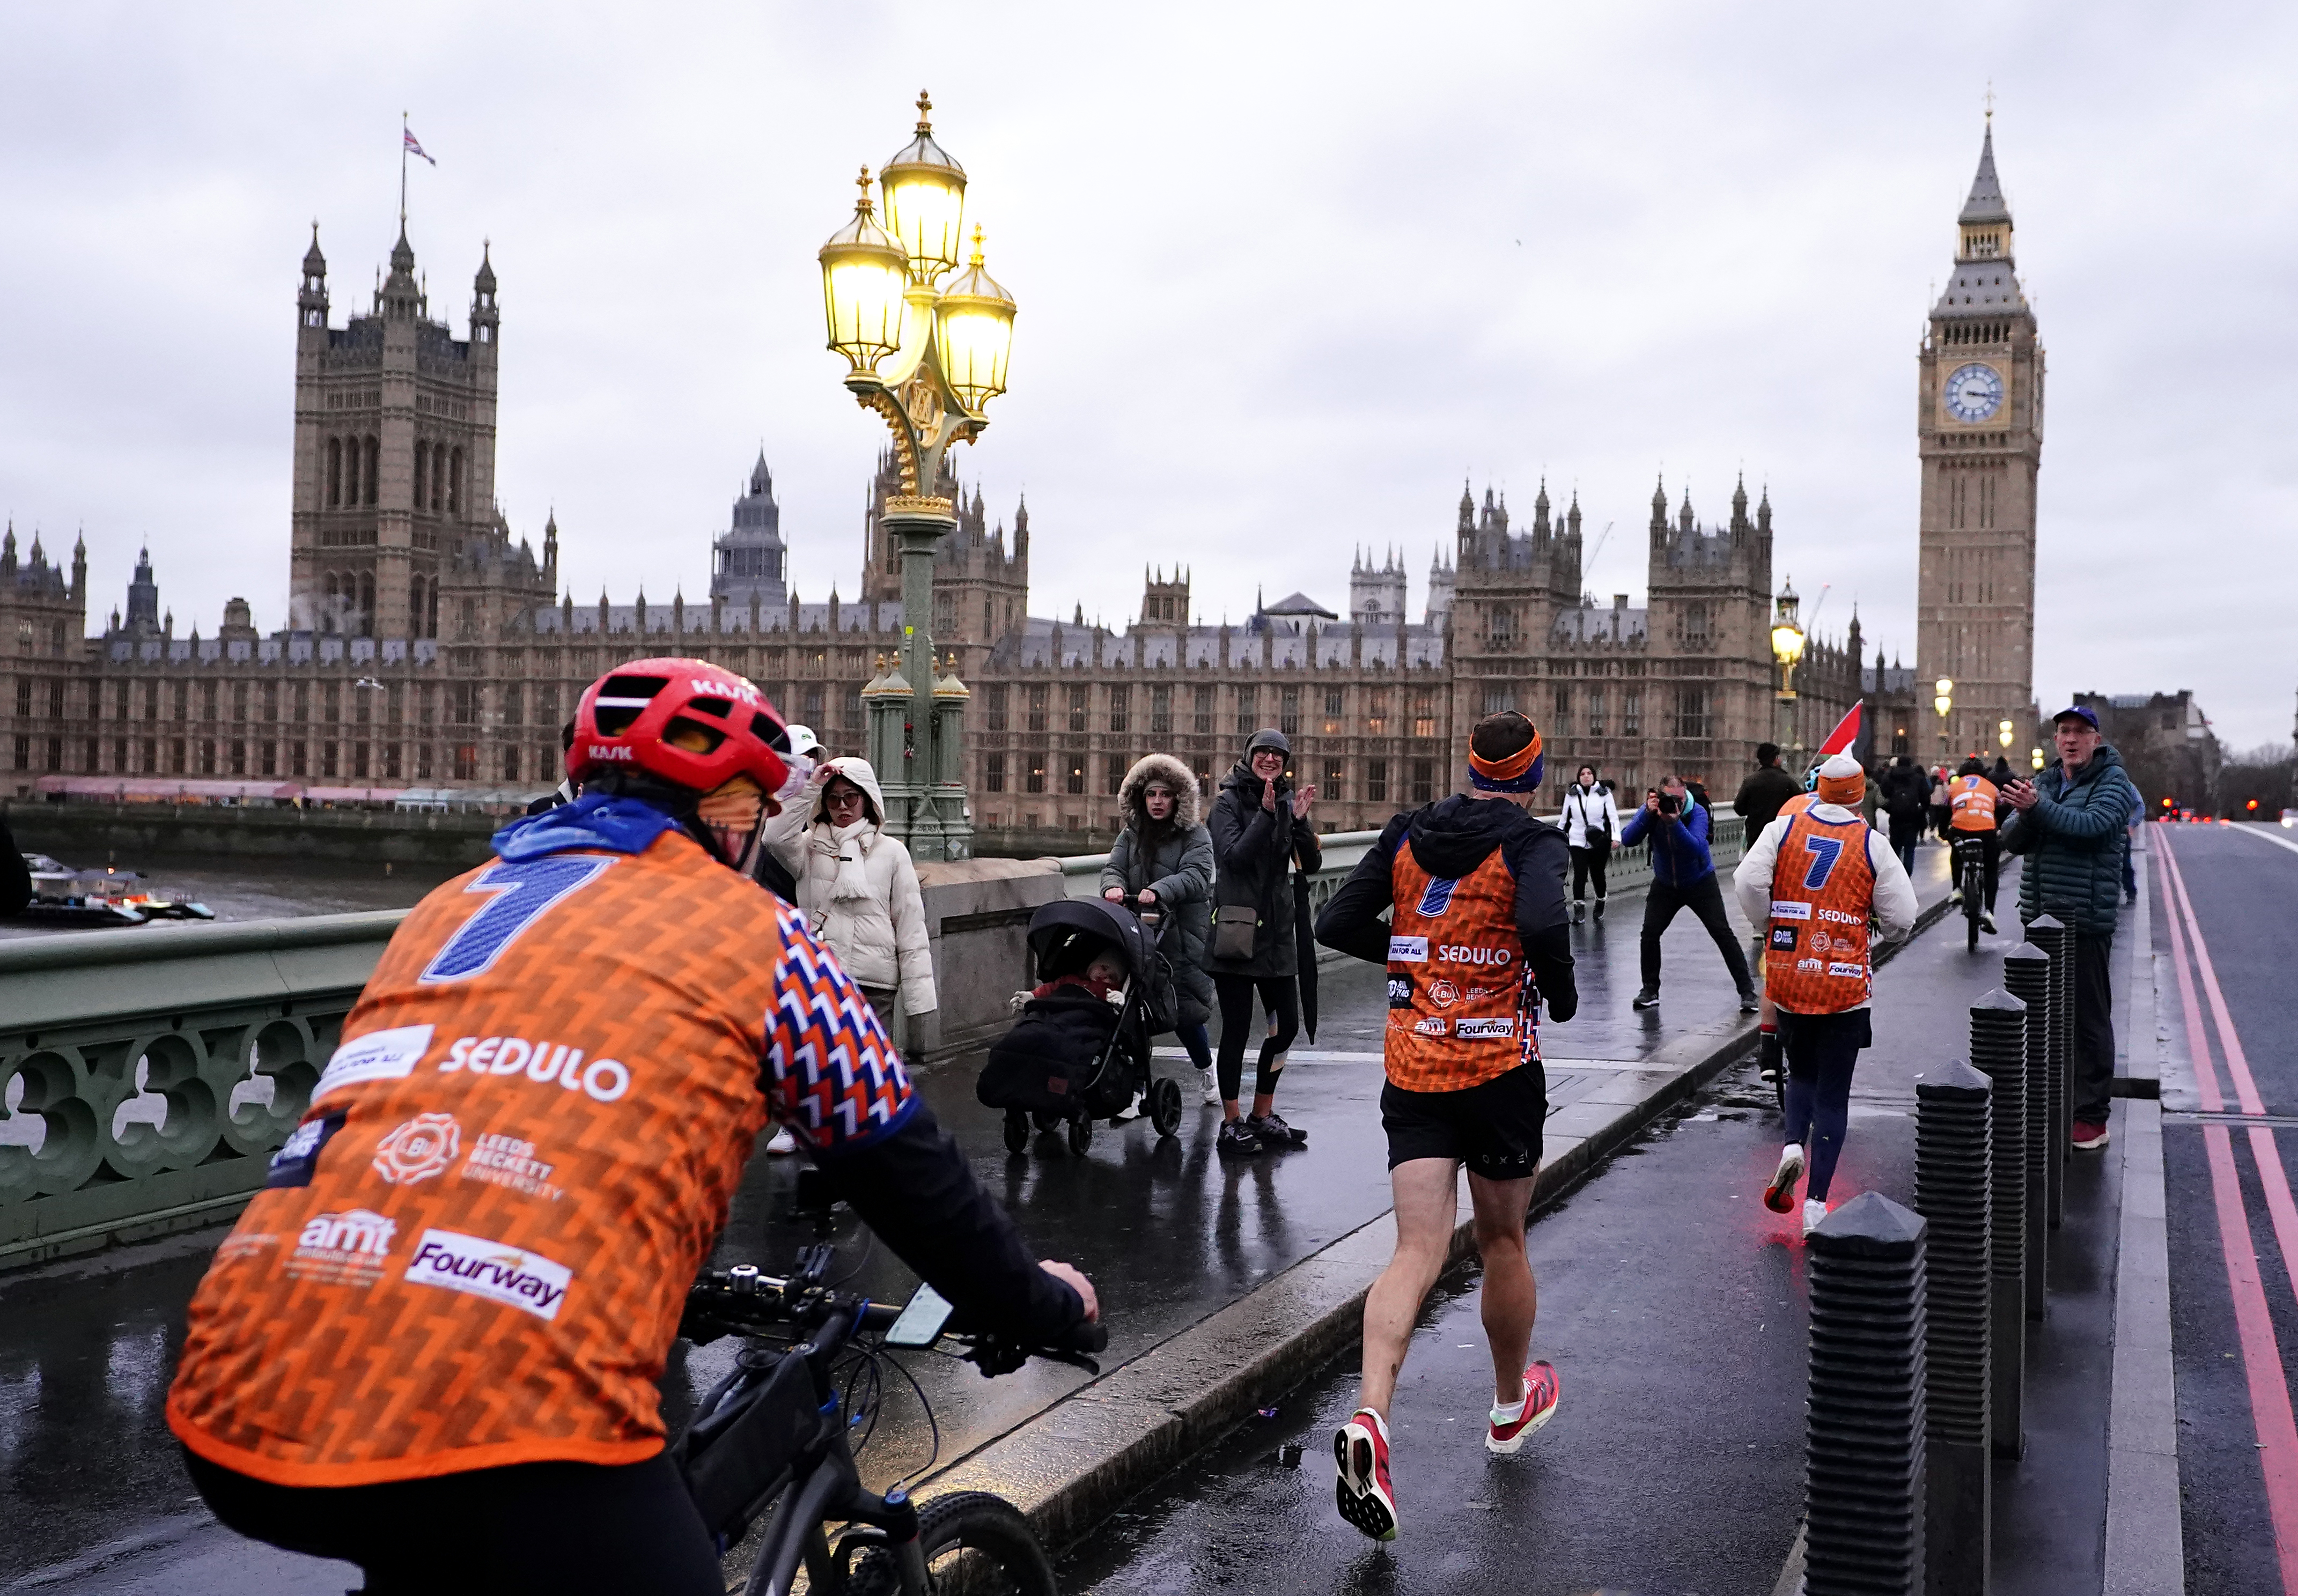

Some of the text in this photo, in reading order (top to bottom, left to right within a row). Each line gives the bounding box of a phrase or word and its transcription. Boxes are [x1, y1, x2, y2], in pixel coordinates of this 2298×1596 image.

[1802, 834, 1844, 891] 7
[417, 854, 620, 985] 7
[1818, 909, 1862, 925] SEDULO
[1439, 945, 1511, 965] SEDULO
[1829, 965, 1863, 976] Fourway
[1414, 1018, 1447, 1032] amt
[1457, 1023, 1513, 1035] Fourway
[439, 1036, 630, 1103] SEDULO
[476, 1133, 535, 1158] LEEDS
[469, 1150, 554, 1179] BECKETT
[298, 1217, 397, 1255] amt
[410, 1243, 563, 1307] Fourway
